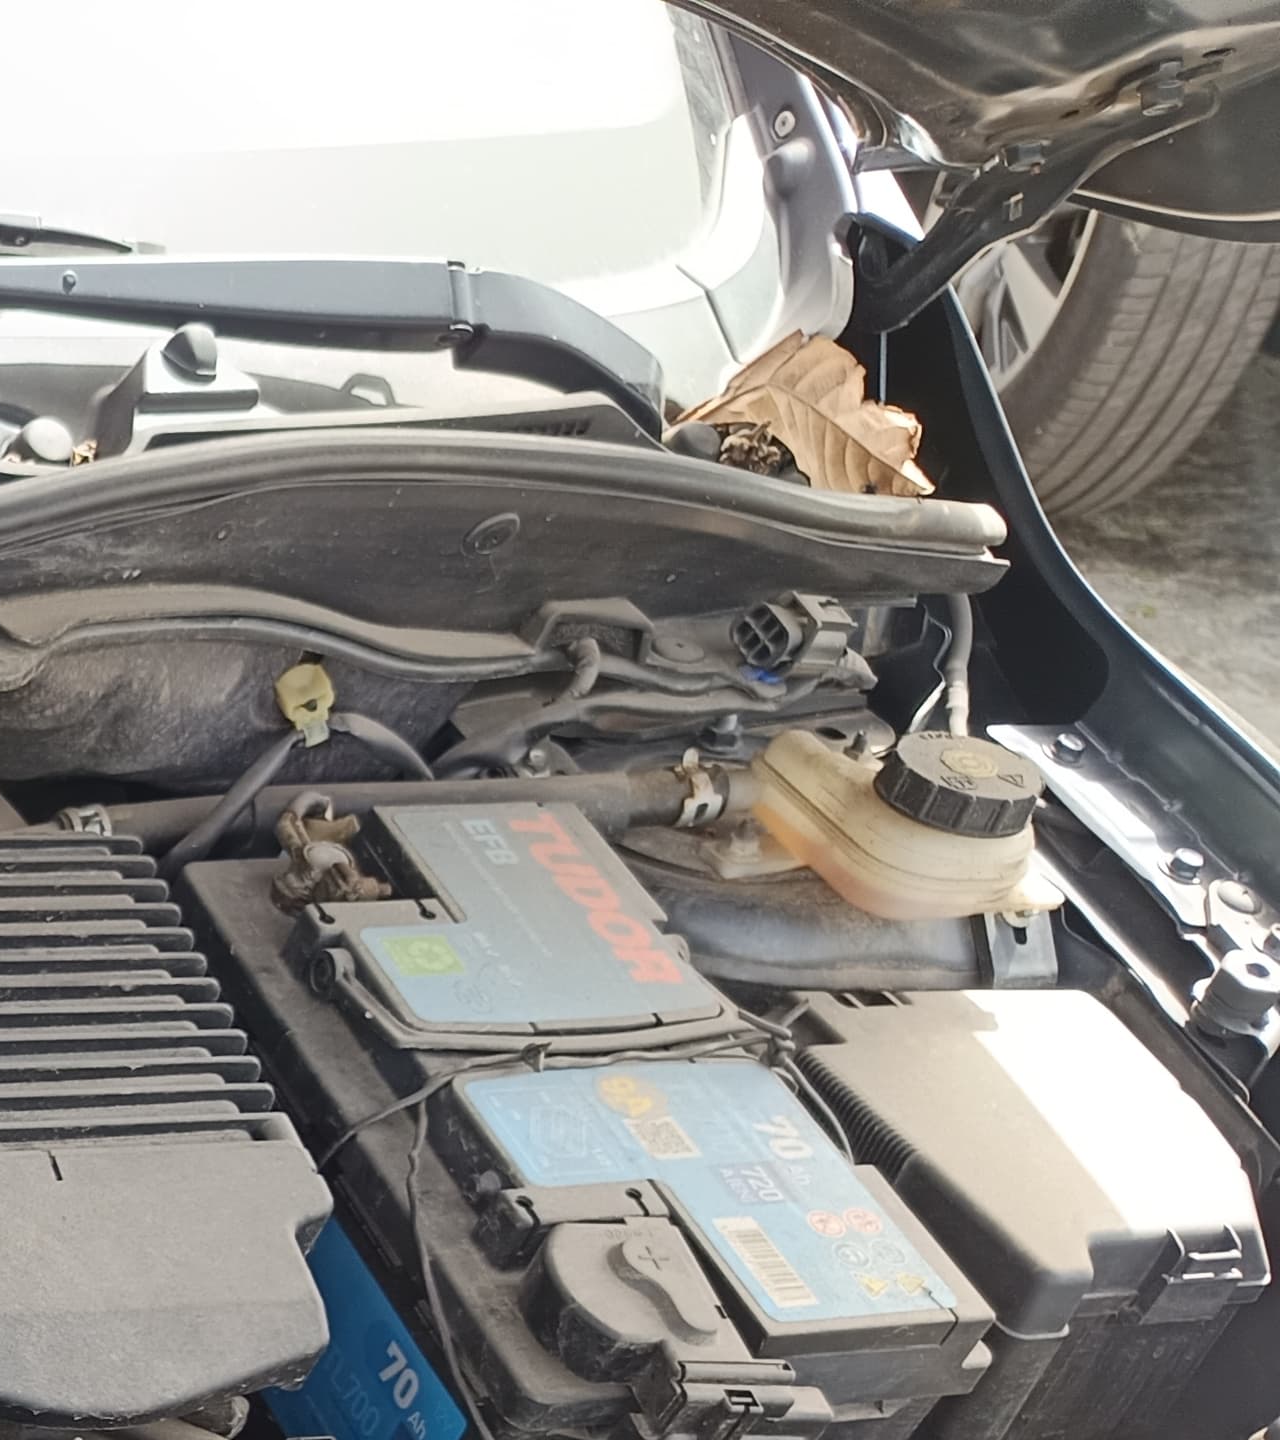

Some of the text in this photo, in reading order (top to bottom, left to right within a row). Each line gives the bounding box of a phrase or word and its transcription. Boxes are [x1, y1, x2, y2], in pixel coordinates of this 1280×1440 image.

[461, 819, 518, 865] EFB
[509, 810, 683, 983] TUDOR
[753, 1114, 815, 1160] 70
[740, 1164, 785, 1202] 720
[378, 1340, 428, 1440] 70 Ah
